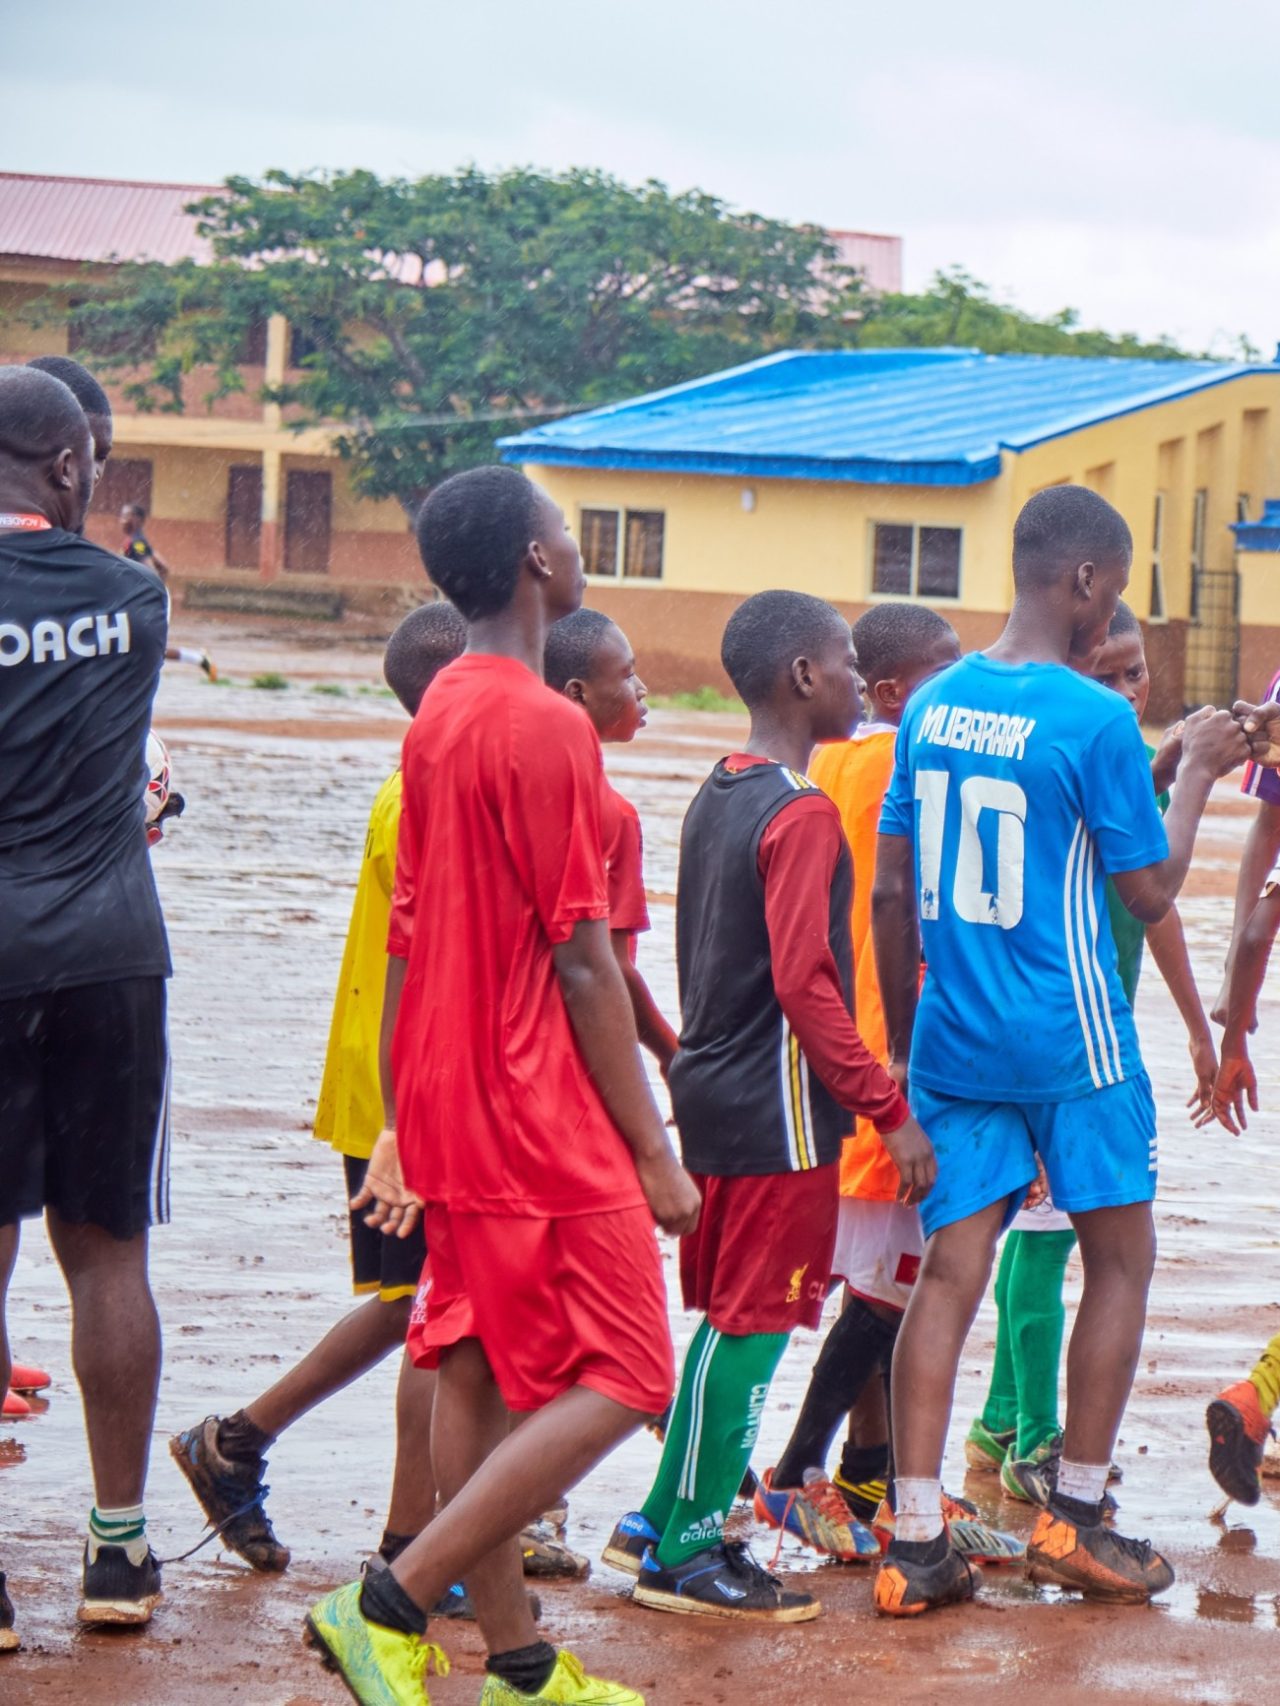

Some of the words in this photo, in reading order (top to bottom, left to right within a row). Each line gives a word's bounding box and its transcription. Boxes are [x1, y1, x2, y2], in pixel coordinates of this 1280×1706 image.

[914, 770, 1027, 930] 10
[740, 1383, 769, 1448] CLINTON
[680, 1527, 724, 1543] adida
